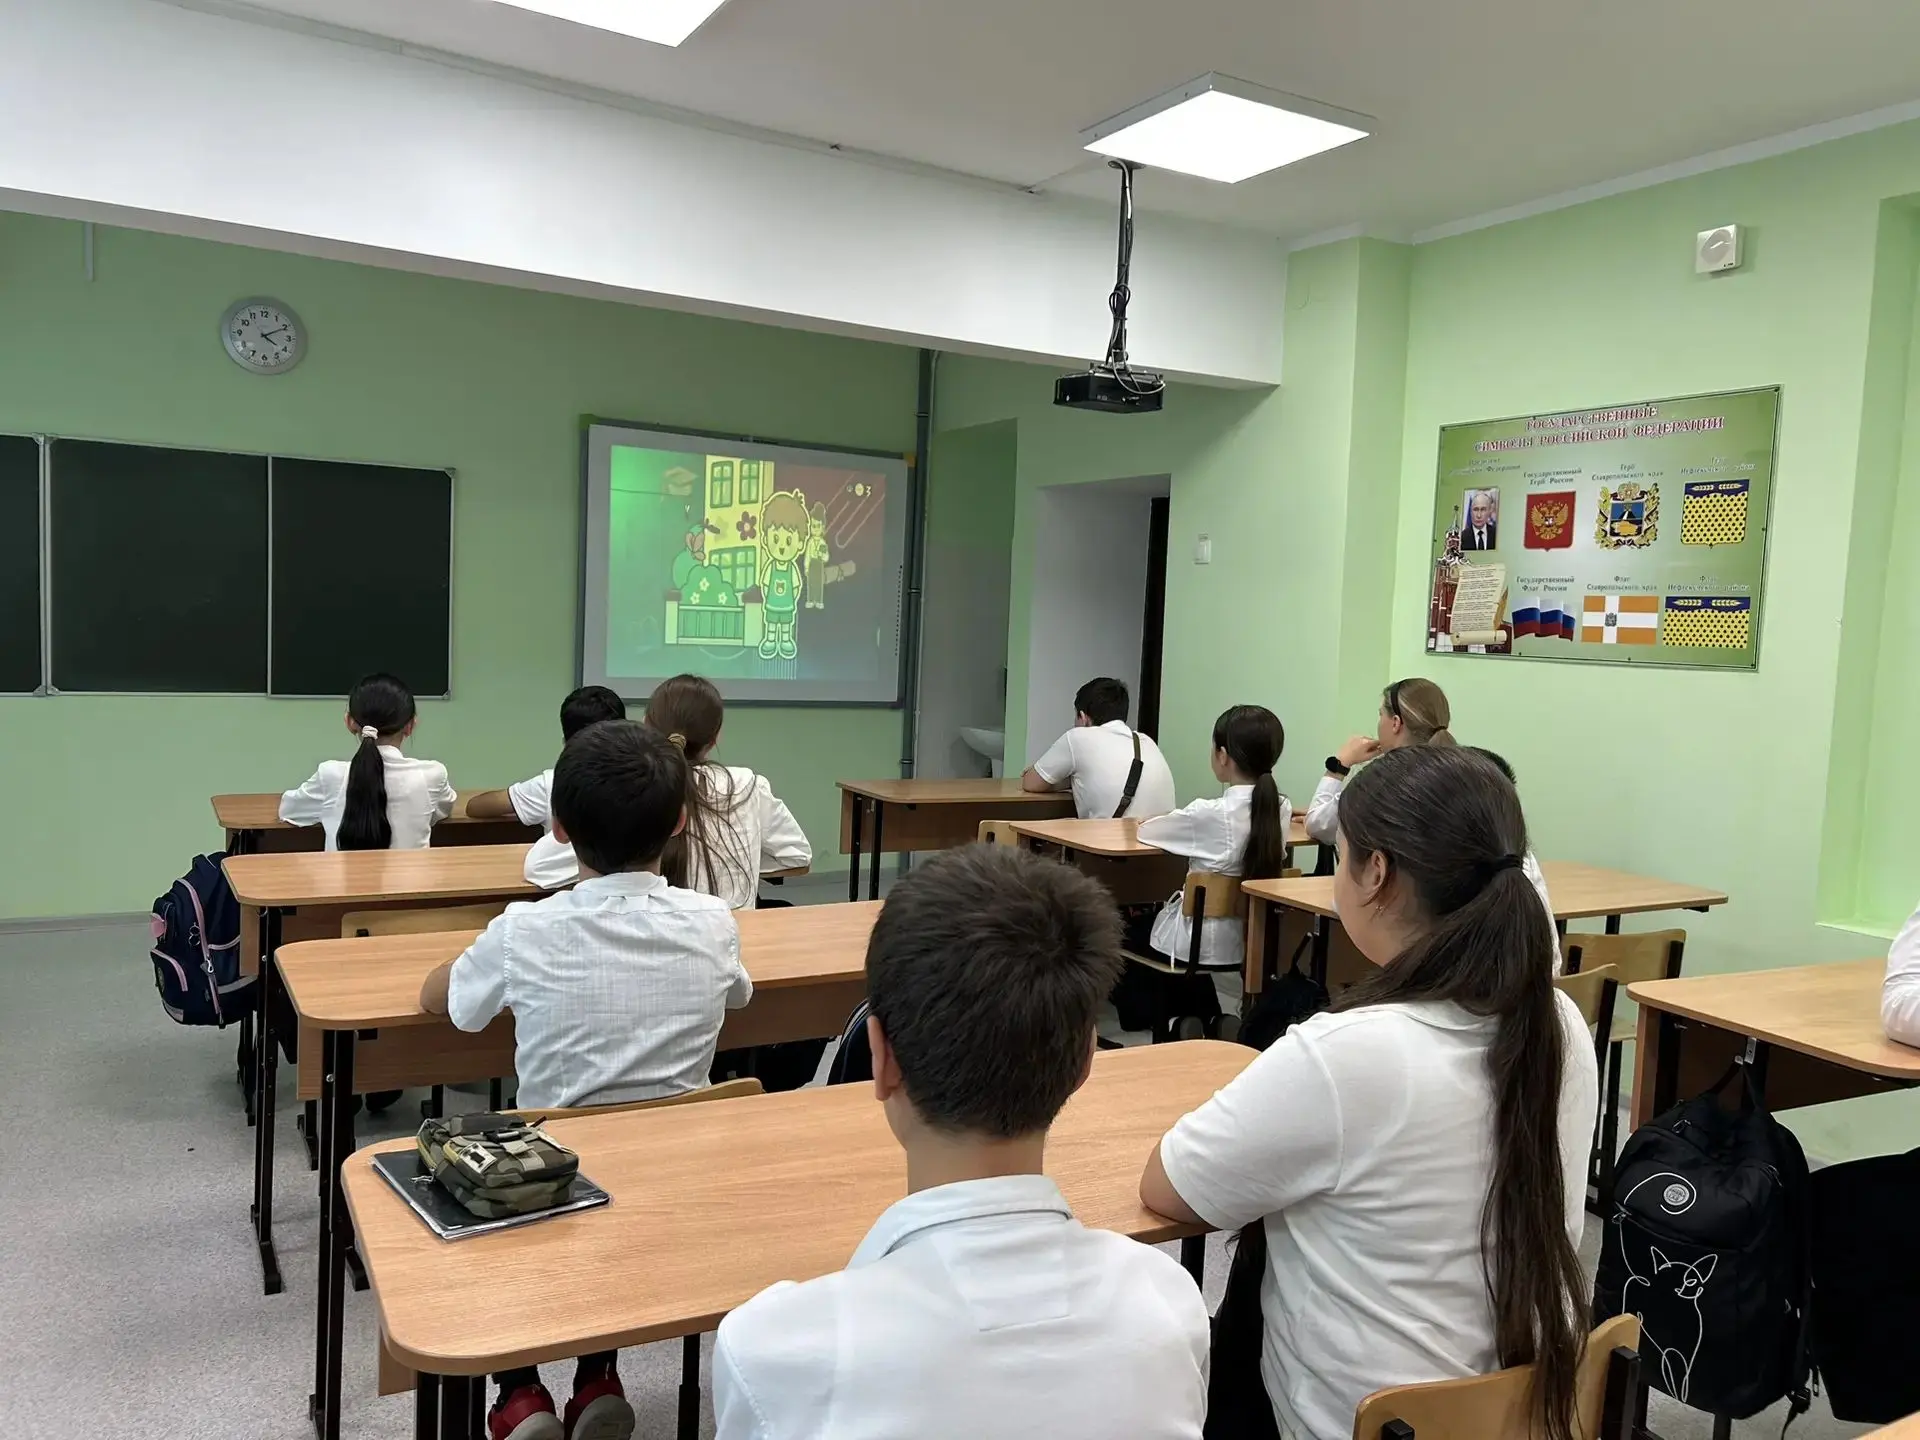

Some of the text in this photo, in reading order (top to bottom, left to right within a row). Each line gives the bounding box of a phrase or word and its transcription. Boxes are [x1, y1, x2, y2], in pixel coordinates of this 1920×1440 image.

[249, 312, 256, 320] 11
[260, 310, 269, 318] 12
[241, 319, 250, 327] 10
[1526, 407, 1658, 431] ГОСУДАРСТВЕННЫЕ
[1634, 416, 1725, 438] ФЕДЕРАЦИИ
